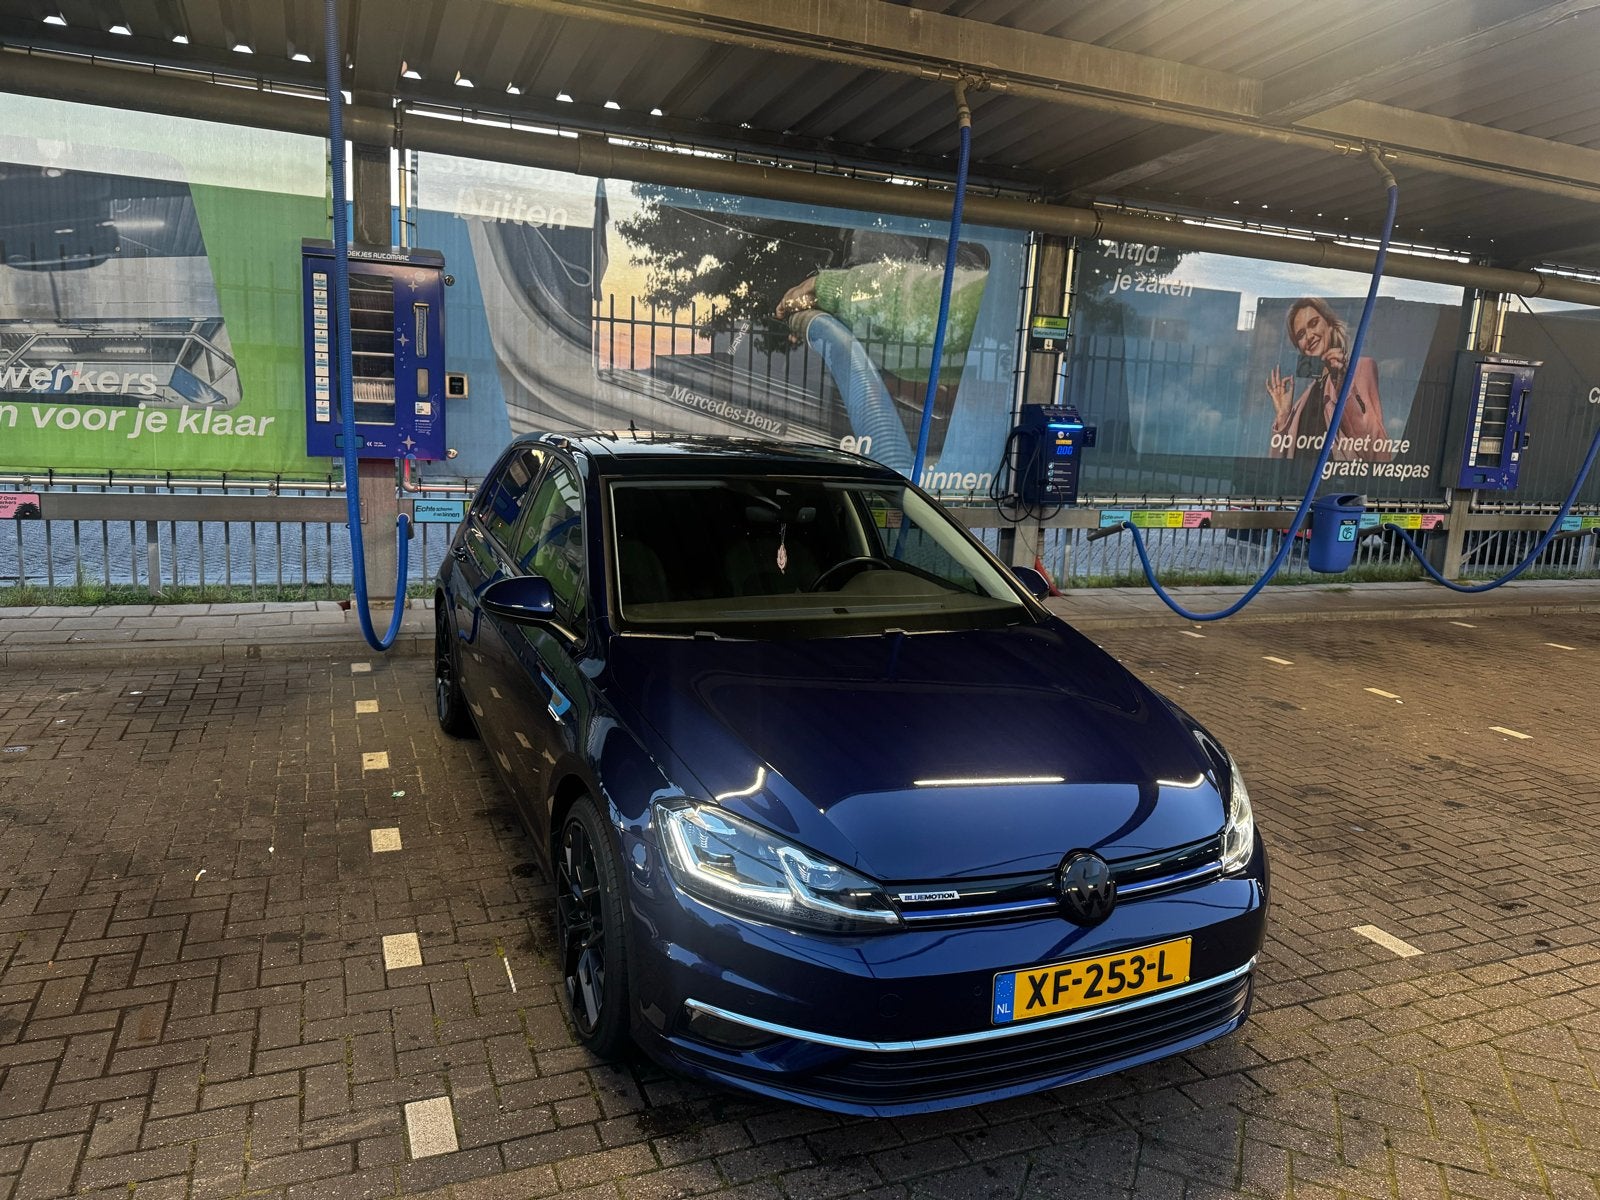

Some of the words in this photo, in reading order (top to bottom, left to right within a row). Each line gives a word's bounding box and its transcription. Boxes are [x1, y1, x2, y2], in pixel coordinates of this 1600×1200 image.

[346, 250, 372, 258] OEKJES
[1109, 268, 1132, 295] je
[1135, 273, 1194, 297] zaken
[32, 406, 127, 431] voor
[127, 402, 169, 439] je
[177, 405, 275, 437] klaar
[669, 384, 784, 435] Mercedes-Benz
[839, 433, 872, 455] en
[1270, 433, 1293, 453] op
[1296, 431, 1335, 451] ord
[1338, 434, 1371, 452] met
[1373, 438, 1410, 454] onze
[1322, 459, 1369, 480] gratis
[1372, 463, 1431, 482] waspas
[904, 892, 955, 902] BLUEMOTION
[1026, 949, 1173, 1009] XF-253-L
[996, 1003, 1011, 1015] NL
